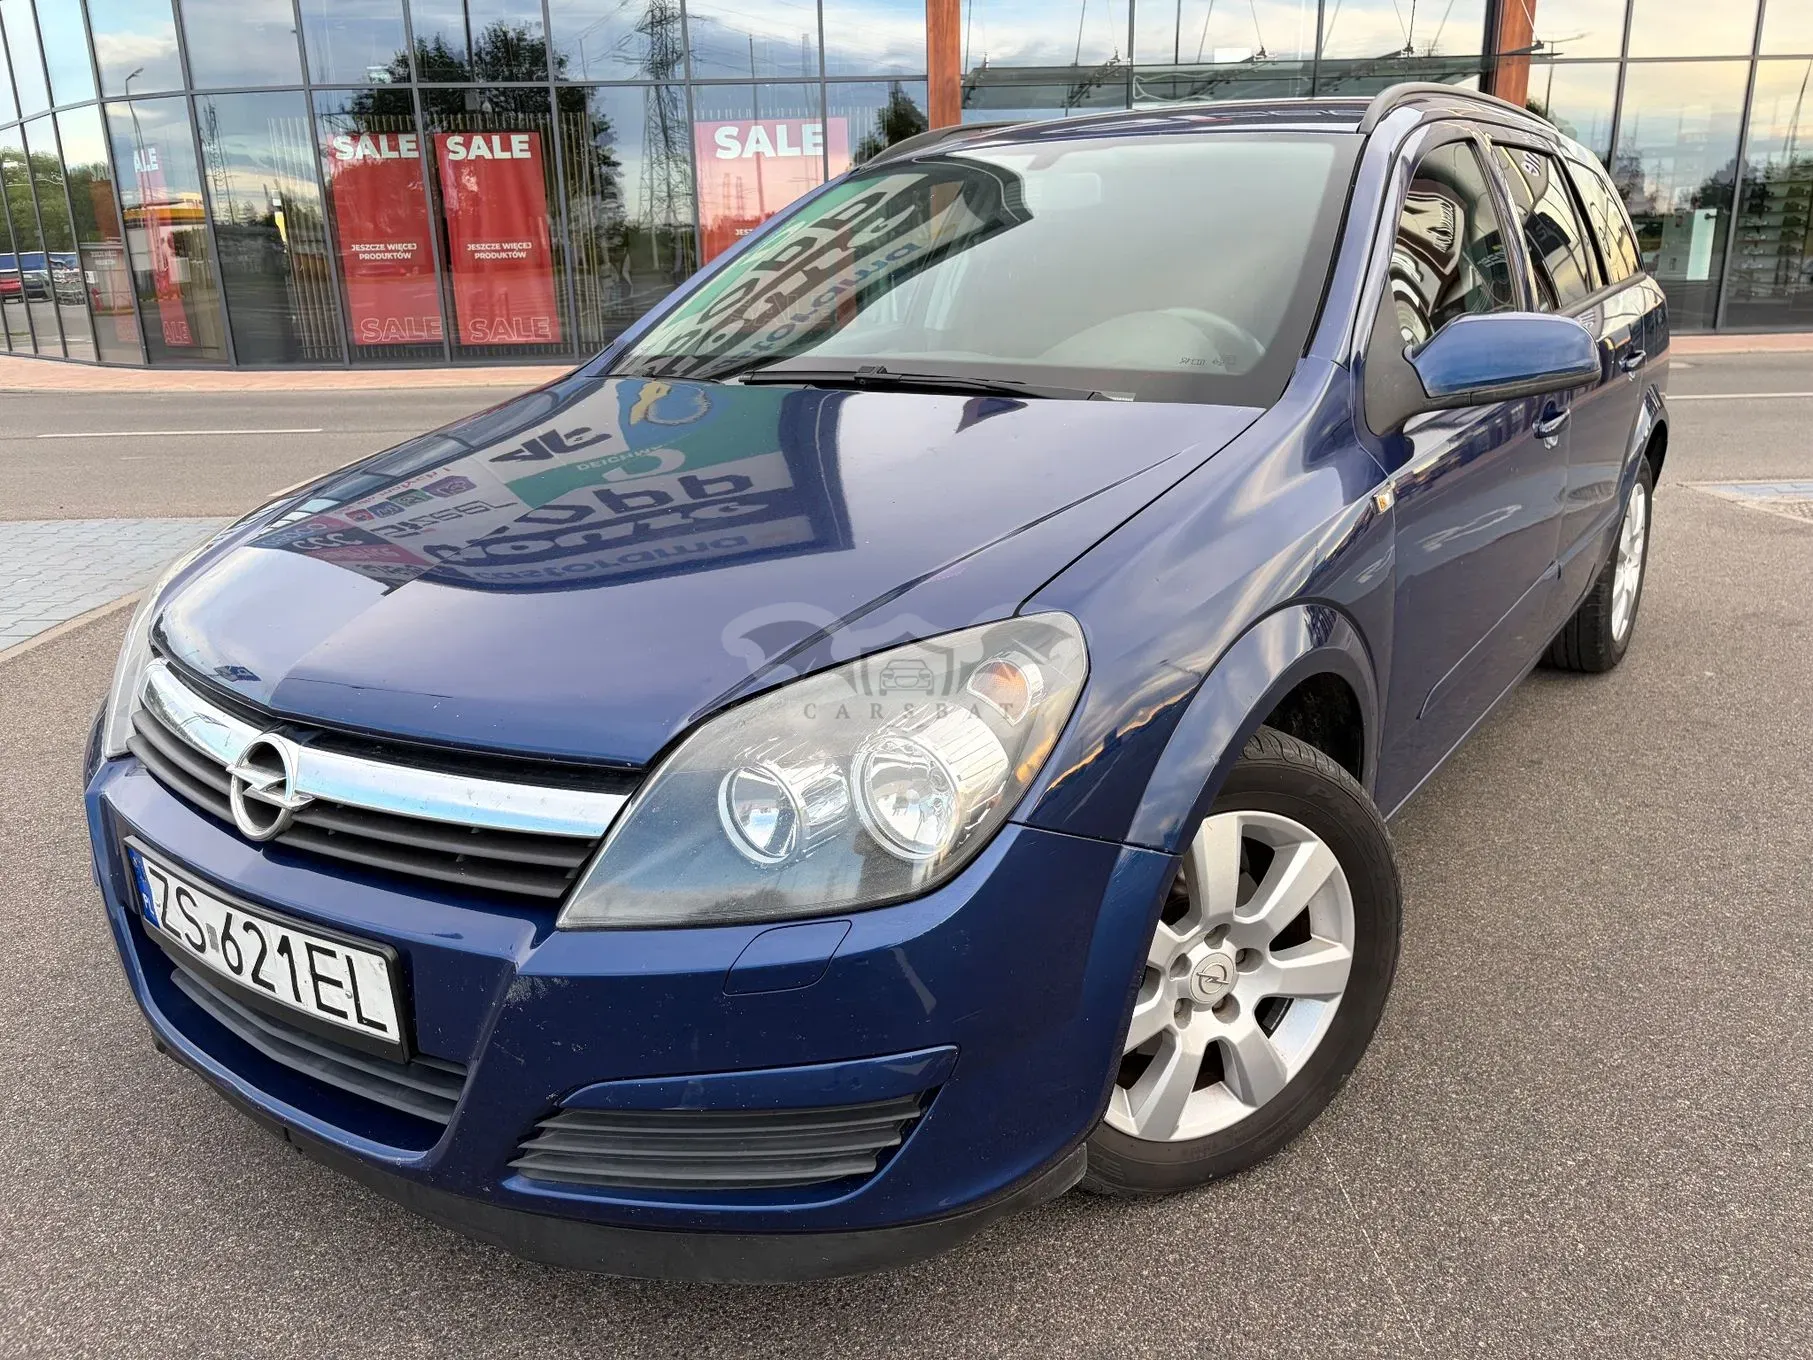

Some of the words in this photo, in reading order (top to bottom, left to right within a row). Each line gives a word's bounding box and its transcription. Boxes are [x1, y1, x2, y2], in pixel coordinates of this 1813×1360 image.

[332, 133, 419, 160] SALE
[446, 134, 532, 160] SALE
[714, 123, 823, 160] SALE
[351, 242, 385, 251] JESZCZE
[387, 242, 417, 252] WIĘCEJ
[359, 250, 412, 260] PRODUKTÓW
[467, 242, 501, 251] JESZCZE
[502, 242, 532, 252] WIĘCEJ
[474, 250, 527, 259] PRODUKTÓW
[360, 316, 443, 342] SALE
[469, 316, 551, 342] SALE
[148, 866, 207, 954] ZS
[220, 911, 389, 1033] 621EL
